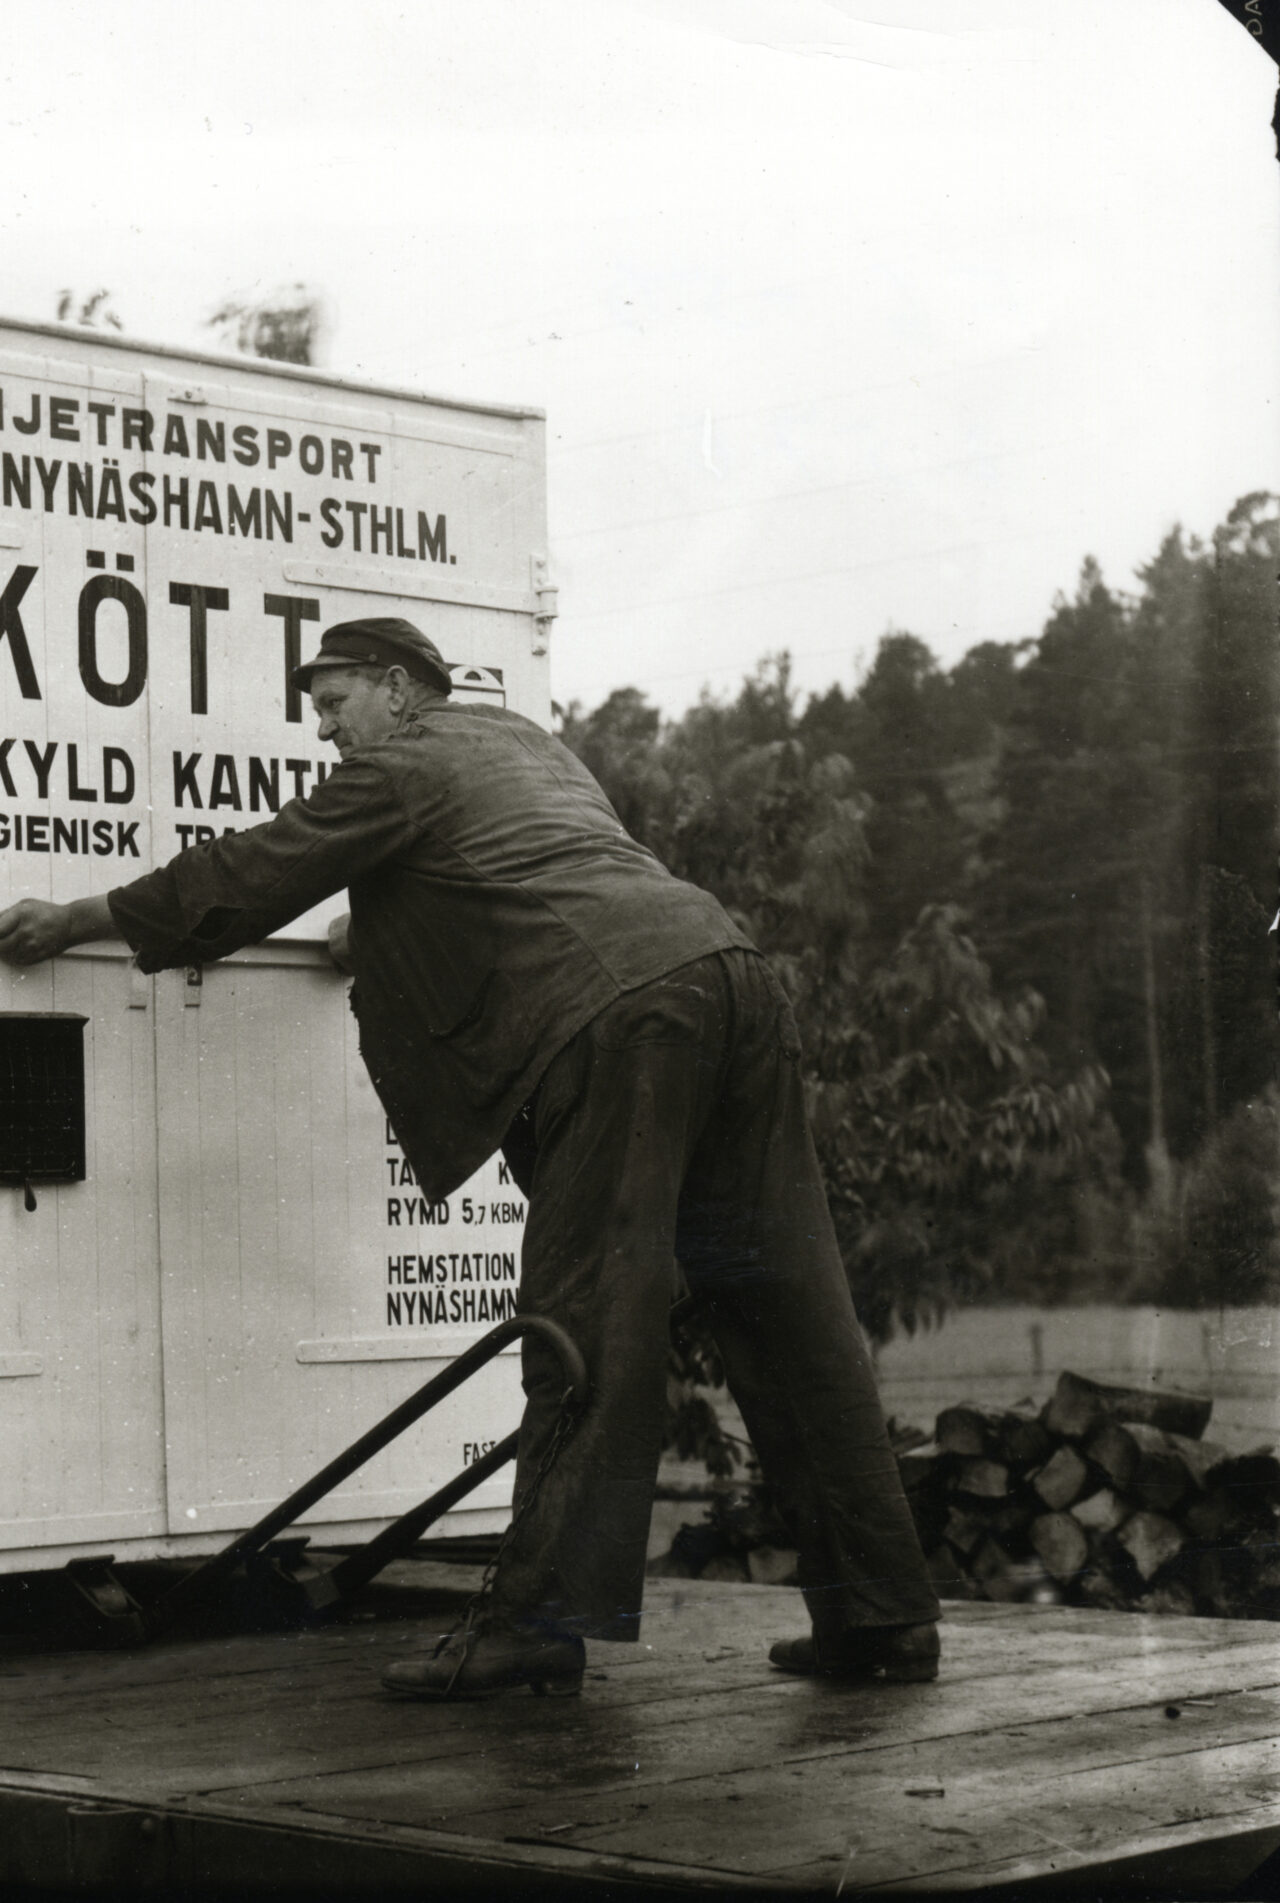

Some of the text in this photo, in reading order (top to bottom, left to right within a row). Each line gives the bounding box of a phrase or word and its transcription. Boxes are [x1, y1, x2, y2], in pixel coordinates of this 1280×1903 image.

[387, 1198, 524, 1226] RYMD 5,7 KBM
[388, 1252, 516, 1285] HEMSTATION
[387, 1284, 521, 1326] NYNÄSHAMN
